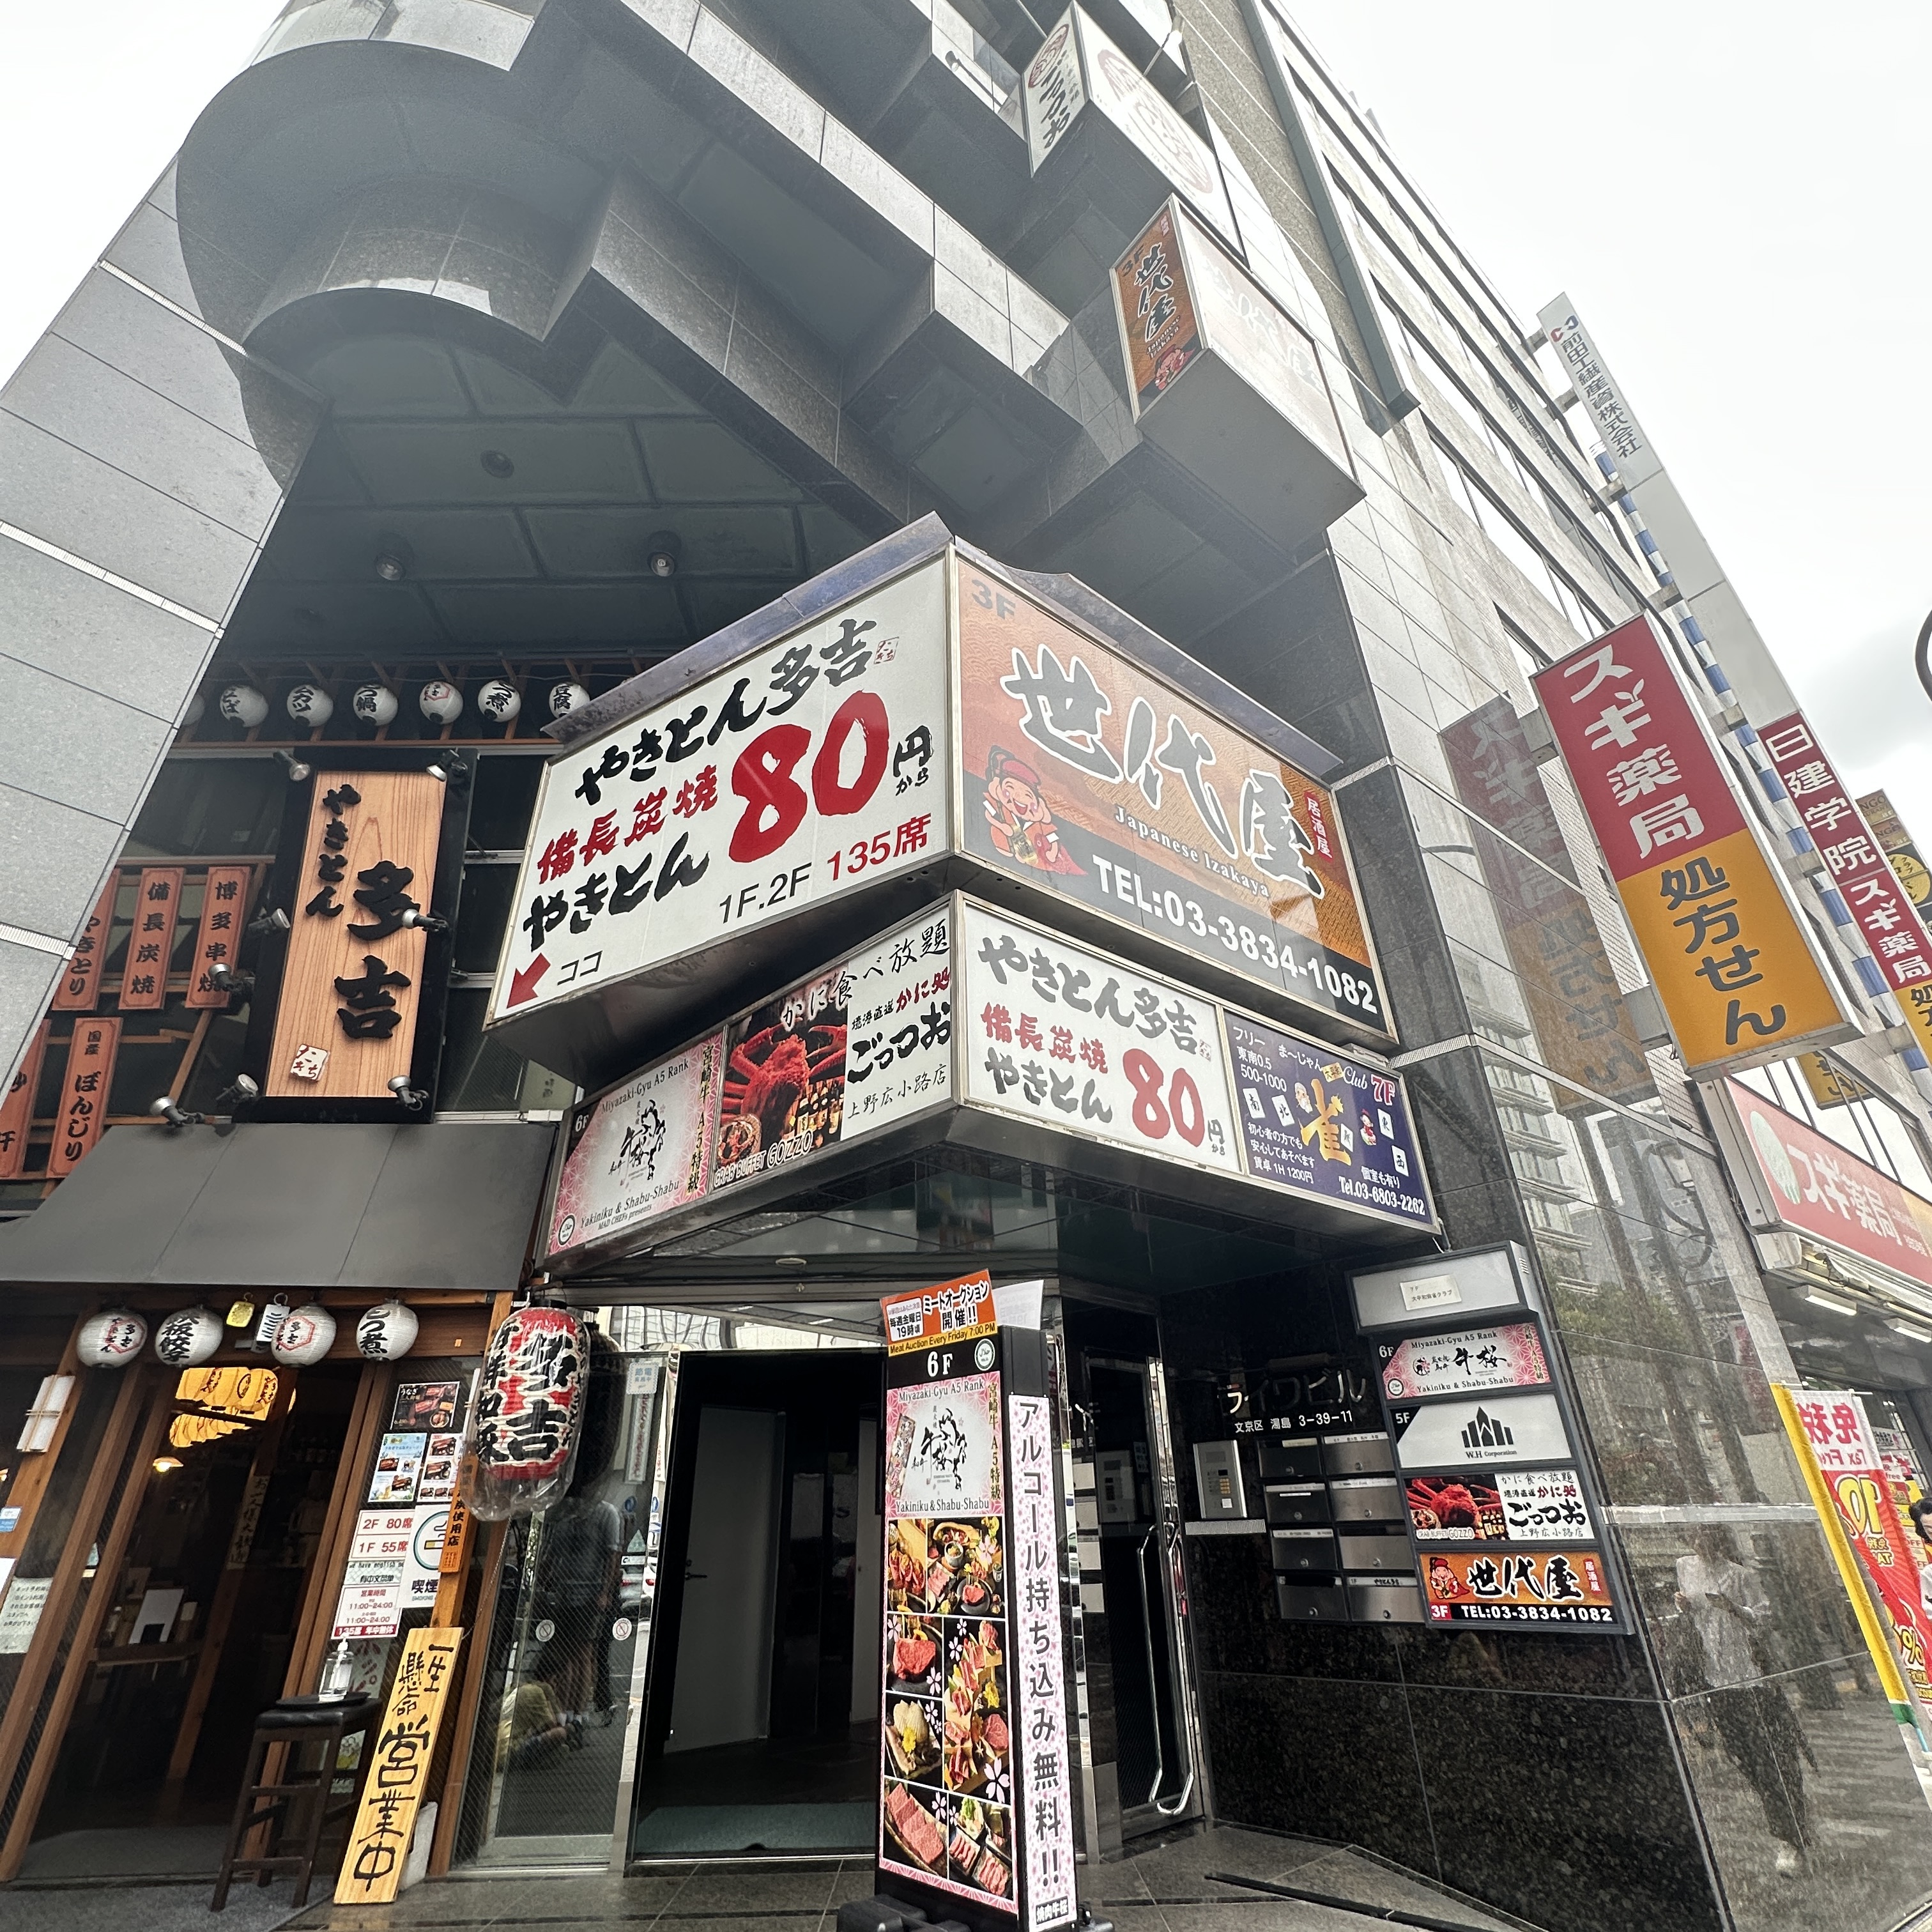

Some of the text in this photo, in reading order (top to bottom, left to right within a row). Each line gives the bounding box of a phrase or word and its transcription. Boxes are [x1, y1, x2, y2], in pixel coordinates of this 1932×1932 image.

[971, 579, 1016, 620] 3F
[574, 618, 877, 806] やきとん多吉
[893, 726, 933, 778] 円
[999, 643, 1326, 900] 世代屋
[1564, 644, 1705, 860] スギ薬局
[729, 689, 890, 863] 80
[896, 768, 930, 797] から
[1765, 724, 1877, 875] 日建学院
[537, 764, 720, 885] 備長炭焼
[1307, 797, 1333, 858] 居酒屋
[305, 783, 361, 918] やきとん
[719, 813, 932, 924] 1F.2F 135席
[1114, 806, 1270, 898] Japanese Izakaya
[523, 832, 710, 953] やきとん
[131, 882, 172, 995] 備長炭焼
[334, 861, 422, 1039] 多吉
[1092, 854, 1379, 1015] TEL:03-3834-1082
[1660, 855, 1786, 1046] 処方せん
[1850, 878, 1931, 983] スギ薬局
[557, 951, 602, 986] ココ
[781, 918, 950, 1031] かに食べ放題
[896, 967, 950, 1012] かに処
[977, 935, 1199, 1055] やきとん多吉
[981, 1002, 1108, 1074] 備長炭焼
[1233, 1026, 1266, 1046] フリー
[1236, 1046, 1273, 1070] 東南0.5
[1343, 1066, 1368, 1090] Club
[601, 1081, 652, 1114] Miyazaki-Gyu
[654, 1070, 665, 1086] A5
[668, 1058, 689, 1079] Rank
[847, 1062, 947, 1119] 上野広小路店
[985, 1046, 1113, 1124] やきとん
[1123, 1048, 1206, 1148] 80
[1241, 1066, 1287, 1092] 500-1000
[1370, 1073, 1395, 1107] 7F
[65, 1071, 102, 1161] ぼんじり
[575, 1114, 589, 1132] 6F
[1208, 1119, 1225, 1144] 円
[1247, 1122, 1303, 1150] 初心者の方でも
[767, 1129, 814, 1169] GOZZO
[1250, 1138, 1315, 1169] 安心してあそべます
[1273, 1162, 1314, 1184] 1H 1200円
[1361, 1166, 1400, 1189] 個室も有り
[580, 1206, 613, 1229] Yakiniku
[624, 1179, 680, 1211] Shabu-Shabu
[1338, 1176, 1425, 1216] Tel.03-6803-2262
[1788, 1144, 1903, 1246] スギ薬局
[924, 1282, 988, 1312] ミートオークション
[889, 1311, 921, 1328] 毎週金曜日
[890, 1323, 995, 1354] Meat Auction Every Friday 7:00 PM
[942, 1306, 976, 1331] 開催!!
[1379, 1345, 1394, 1358] 6F
[1411, 1336, 1462, 1349] Miyazaki-Gyu
[1478, 1331, 1498, 1340] Rank
[927, 1351, 953, 1377] 6F
[899, 1378, 985, 1402] Miyazaki-Gyu A5 Rank
[1416, 1381, 1451, 1393] Yakiniku
[1462, 1376, 1514, 1388] Shabu-Shabu
[1234, 1419, 1264, 1434] 文京区
[1298, 1409, 1353, 1427] 3-39-11
[1395, 1412, 1410, 1425] 5F
[1484, 1449, 1517, 1458] Corporation
[1501, 1471, 1575, 1485] かに食べ放題
[363, 1517, 413, 1529] 2F 80席
[896, 1497, 990, 1513] Yakiniku & Shabu-Shabu
[359, 1542, 376, 1553] 1F
[1448, 1528, 1473, 1538] GOZZO
[1466, 1554, 1584, 1602] 世代屋
[1431, 1604, 1613, 1623] 3F TEL:03-3834-1082
[1019, 1402, 1061, 1889] アルコール持ち込み無料!!
[424, 1644, 454, 1692] 一生
[353, 1713, 430, 1892] 営業中
